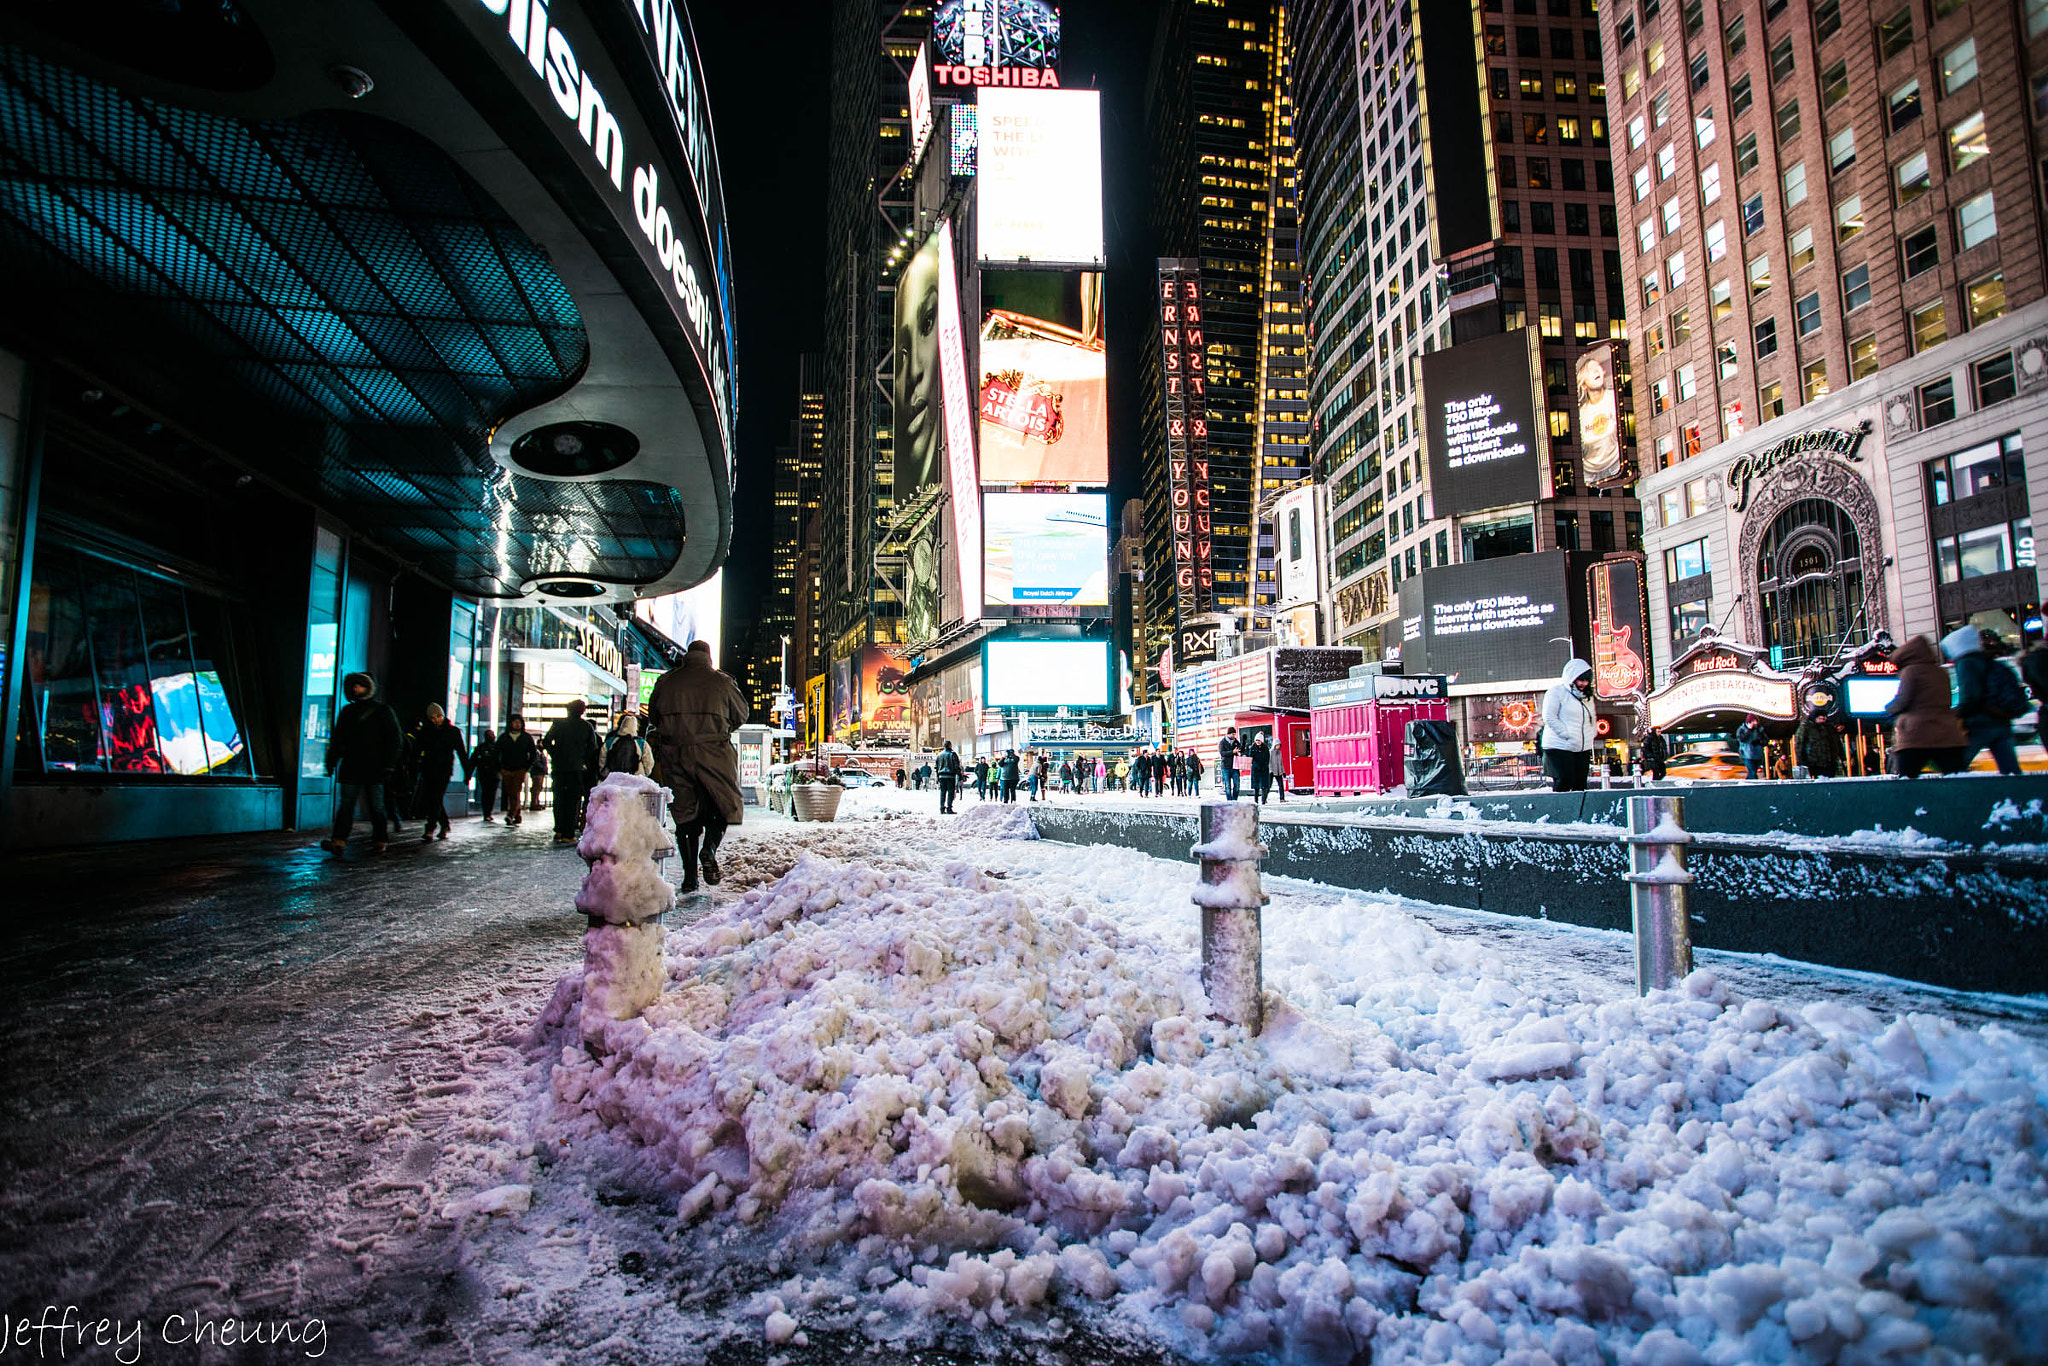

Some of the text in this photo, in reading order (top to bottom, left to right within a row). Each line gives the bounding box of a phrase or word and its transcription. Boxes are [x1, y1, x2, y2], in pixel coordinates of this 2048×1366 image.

[933, 64, 1060, 88] TOSHIBA
[478, 0, 713, 372] lism doesn't
[987, 387, 1049, 418] STELA
[1445, 394, 1492, 413] The only
[1445, 404, 1501, 424] 750 Mbps
[1163, 282, 1194, 588] ERNST & YOUNG
[1447, 422, 1519, 446] with uploads
[1448, 447, 1463, 457] as
[1448, 443, 1526, 468] as downloads
[1727, 419, 1873, 513] Paramount
[1800, 555, 1818, 568] 1501
[1023, 590, 1040, 598] Royal
[1433, 595, 1529, 615] The only 750 Mbps
[1474, 608, 1497, 621] with
[1497, 603, 1540, 619] uploads
[1540, 603, 1555, 613] as
[1469, 622, 1482, 632] as
[577, 624, 623, 680] SEPHORA
[1693, 653, 1738, 673] Hard Rock
[1863, 660, 1884, 673] Hard
[1599, 667, 1641, 680] Hard Rock
[1328, 681, 1348, 692] Official
[1348, 679, 1366, 690] Guide
[1690, 682, 1707, 696] FOR
[1708, 679, 1768, 694] BREAKFAST
[867, 721, 884, 730] BOY
[886, 721, 911, 730] WON
[743, 743, 760, 752] ATM
